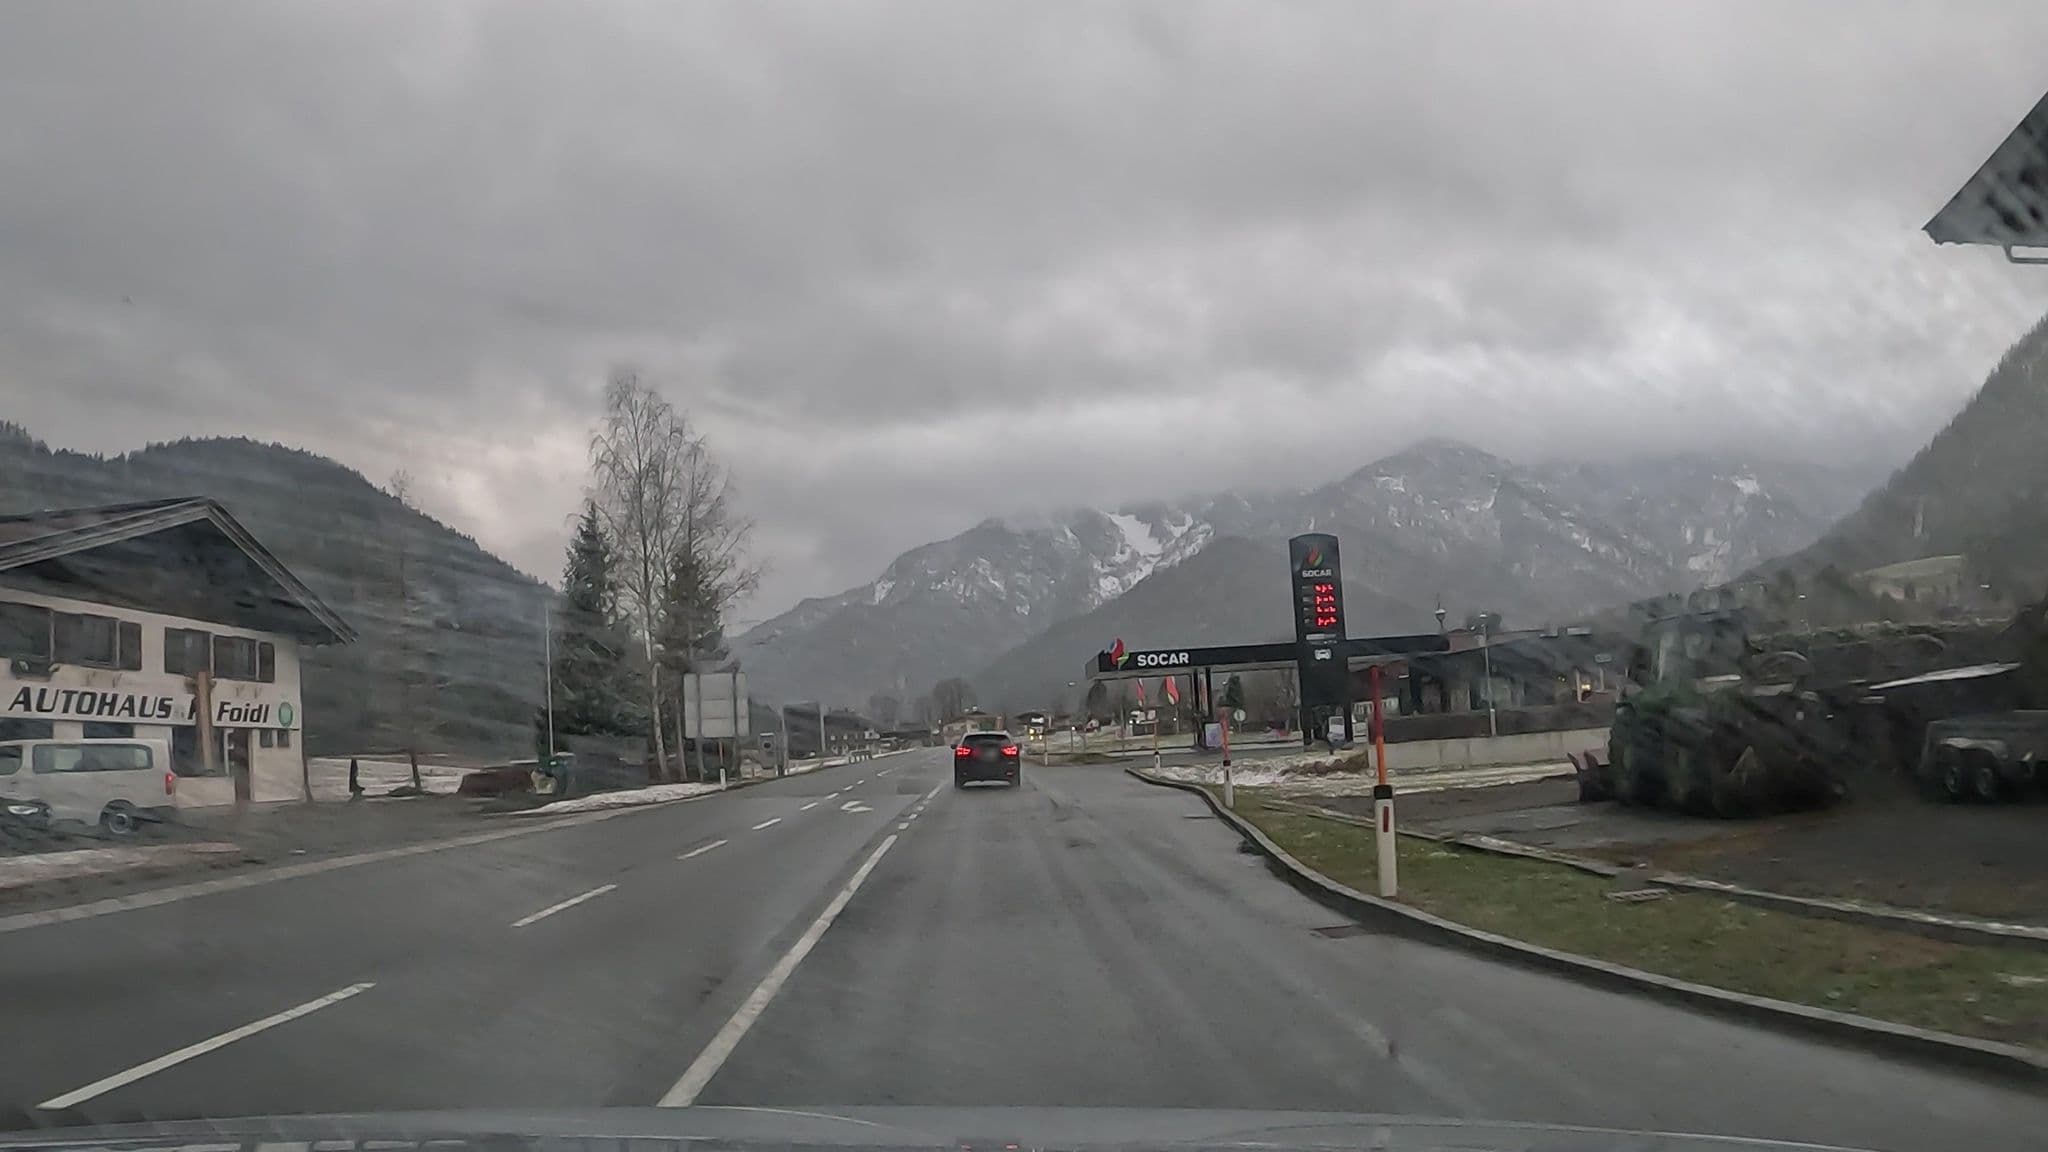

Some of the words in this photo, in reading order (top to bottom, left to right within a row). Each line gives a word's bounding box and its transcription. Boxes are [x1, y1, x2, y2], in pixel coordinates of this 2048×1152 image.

[1302, 569, 1332, 578] SOCAR
[1137, 652, 1189, 667] SOCAR
[9, 686, 173, 719] AUTOHAUS
[216, 701, 270, 723] Foidl
